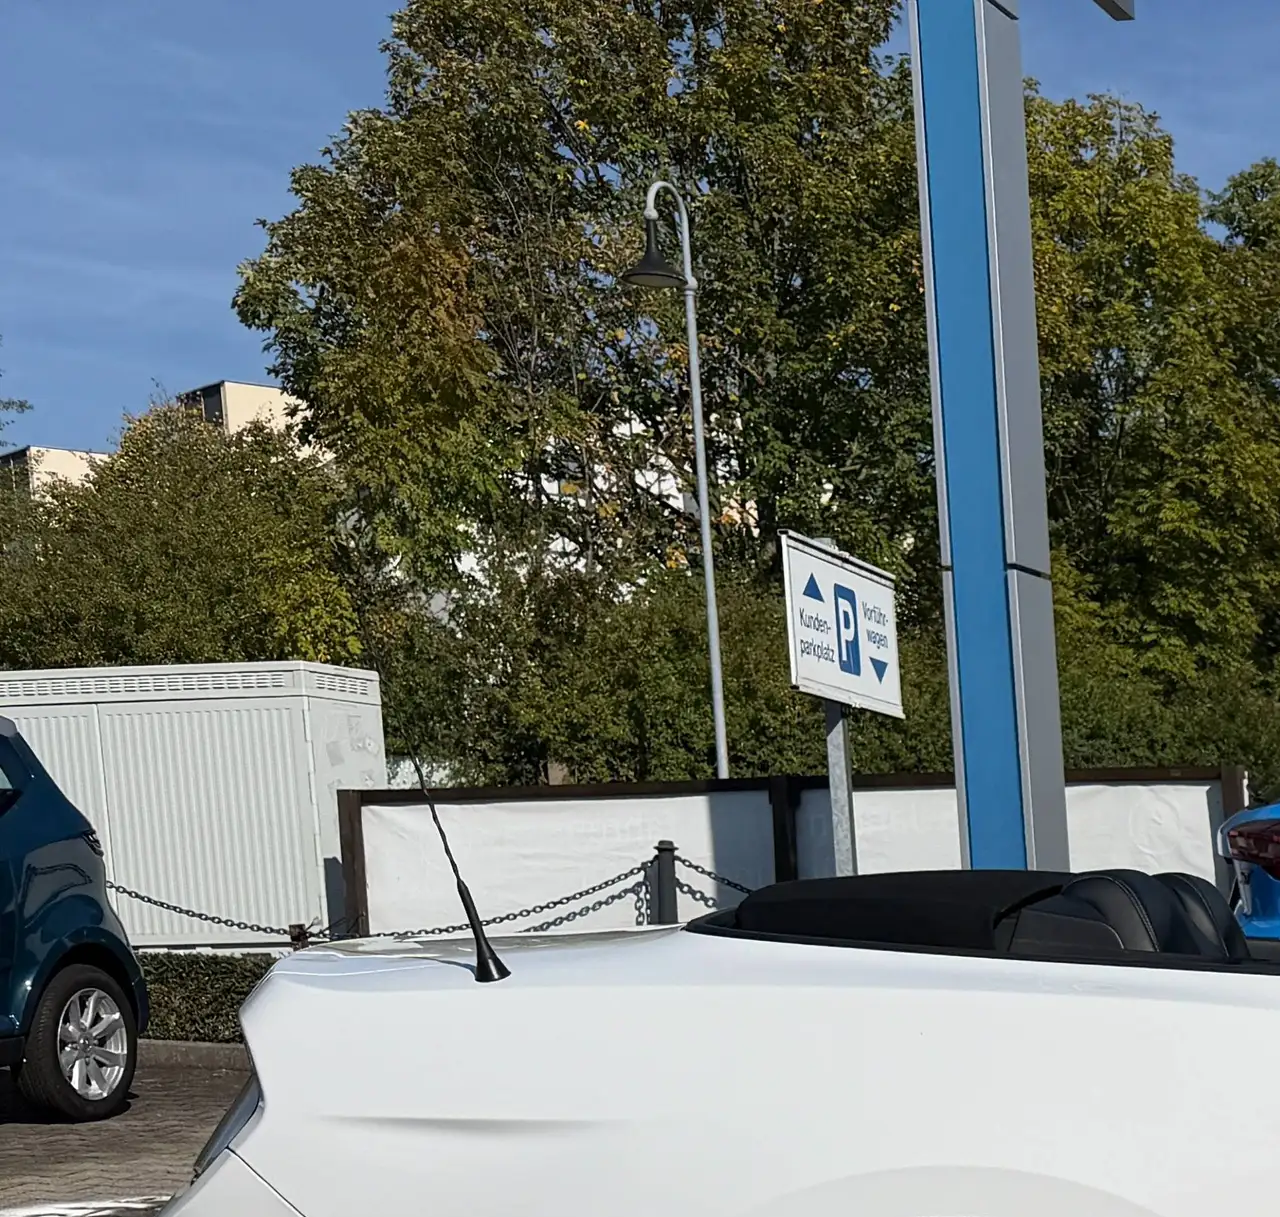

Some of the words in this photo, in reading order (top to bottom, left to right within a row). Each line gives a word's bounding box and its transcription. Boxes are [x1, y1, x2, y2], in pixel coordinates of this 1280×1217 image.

[799, 607, 831, 635] Kunden-
[862, 601, 888, 627] Vorführ-
[838, 597, 855, 661] P
[866, 628, 889, 650] wagen
[800, 637, 836, 663] parkplatz
